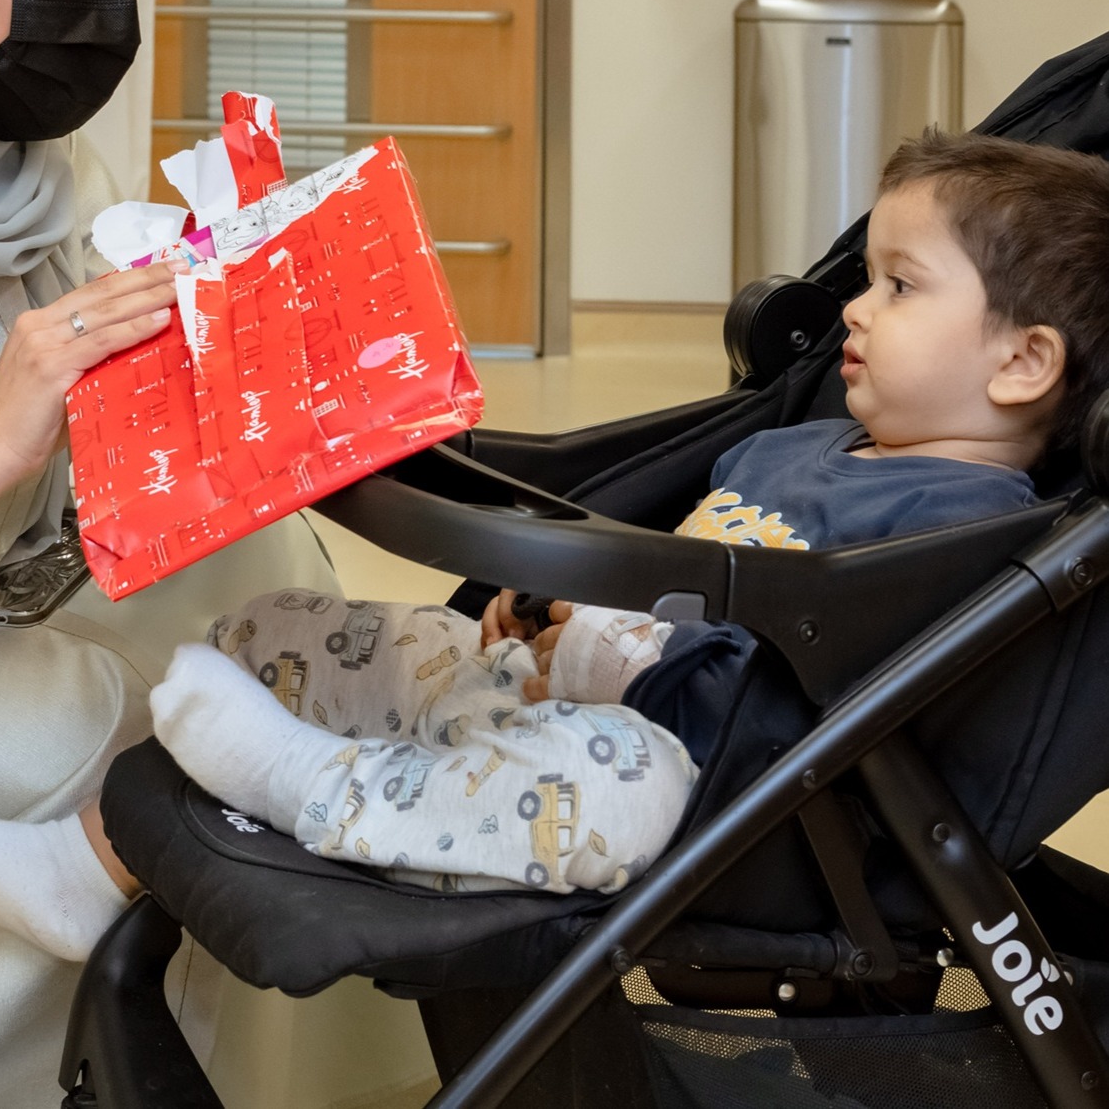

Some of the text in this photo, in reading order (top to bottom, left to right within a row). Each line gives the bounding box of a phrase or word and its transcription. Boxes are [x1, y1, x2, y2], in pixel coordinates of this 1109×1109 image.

[387, 330, 431, 380] Hamleys
[239, 389, 272, 442] Hamleys
[138, 448, 180, 496] Hamleys
[971, 911, 1063, 1036] Joie
